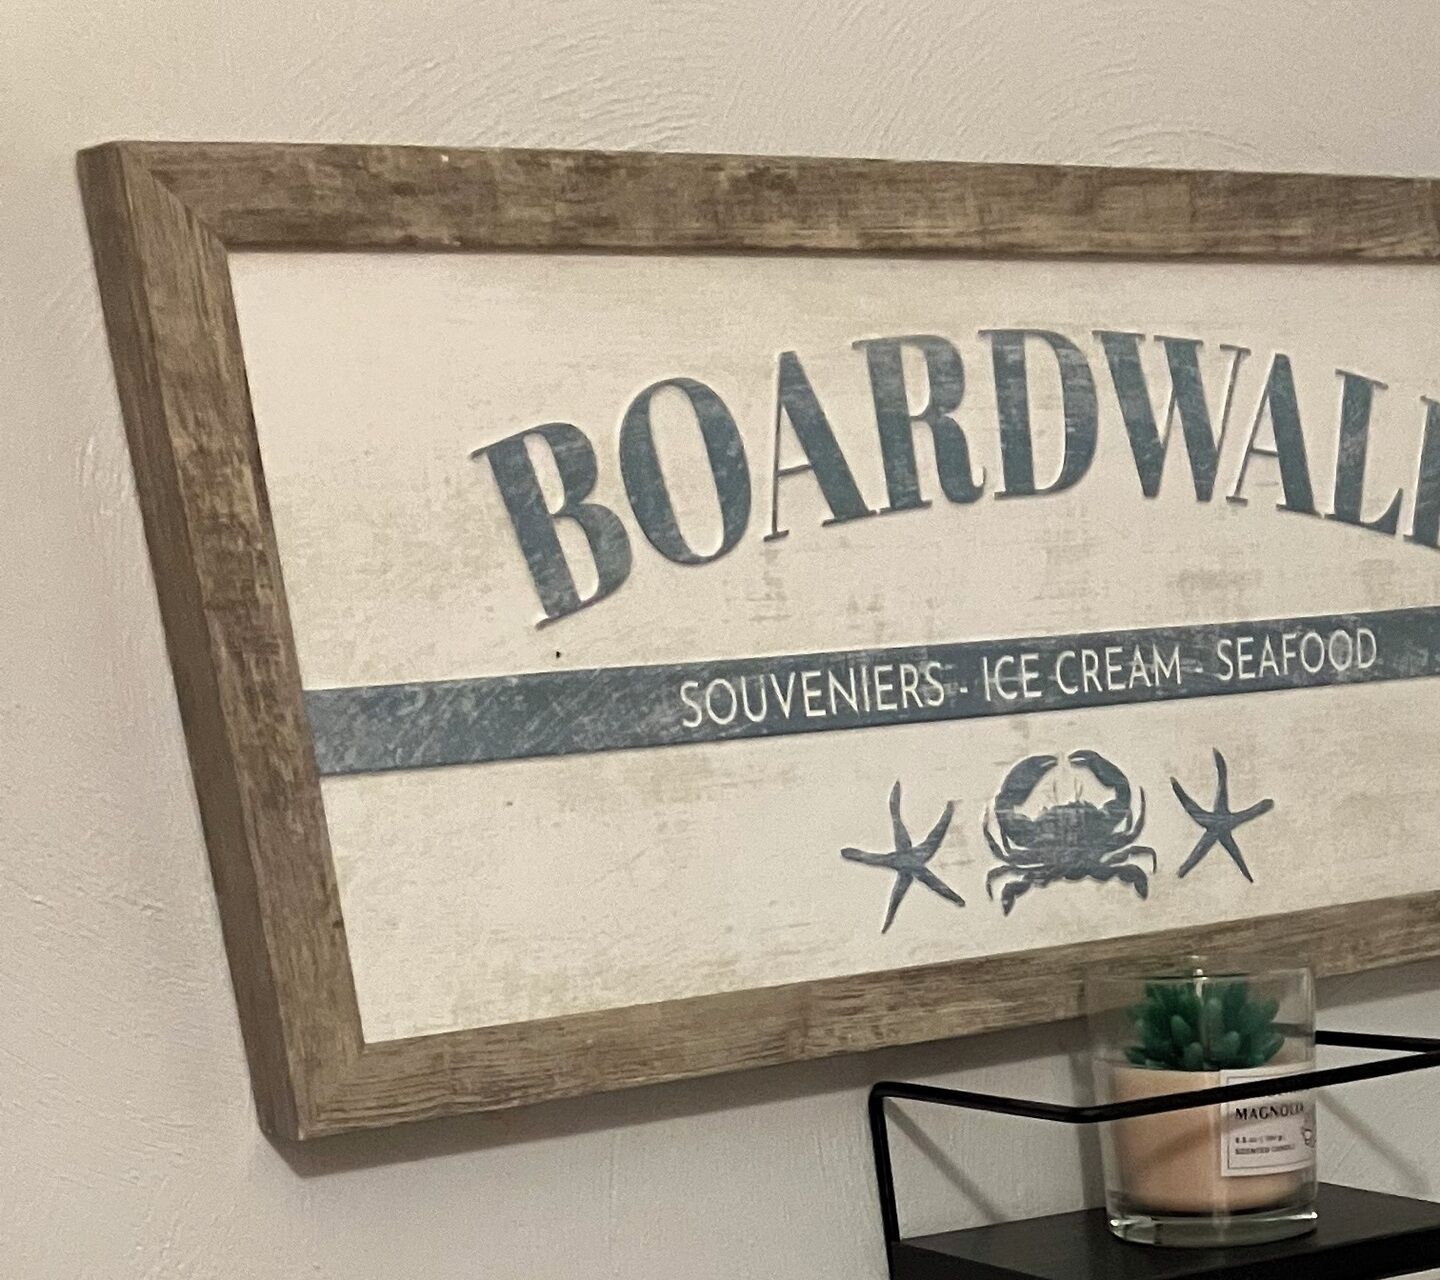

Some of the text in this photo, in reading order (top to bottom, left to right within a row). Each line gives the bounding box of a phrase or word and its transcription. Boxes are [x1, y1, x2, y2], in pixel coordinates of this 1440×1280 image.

[679, 661, 946, 729] SOUVENIERS
[982, 652, 1044, 702] ICE
[1054, 643, 1183, 697] CREAM
[1215, 627, 1378, 682] SEAFOOD
